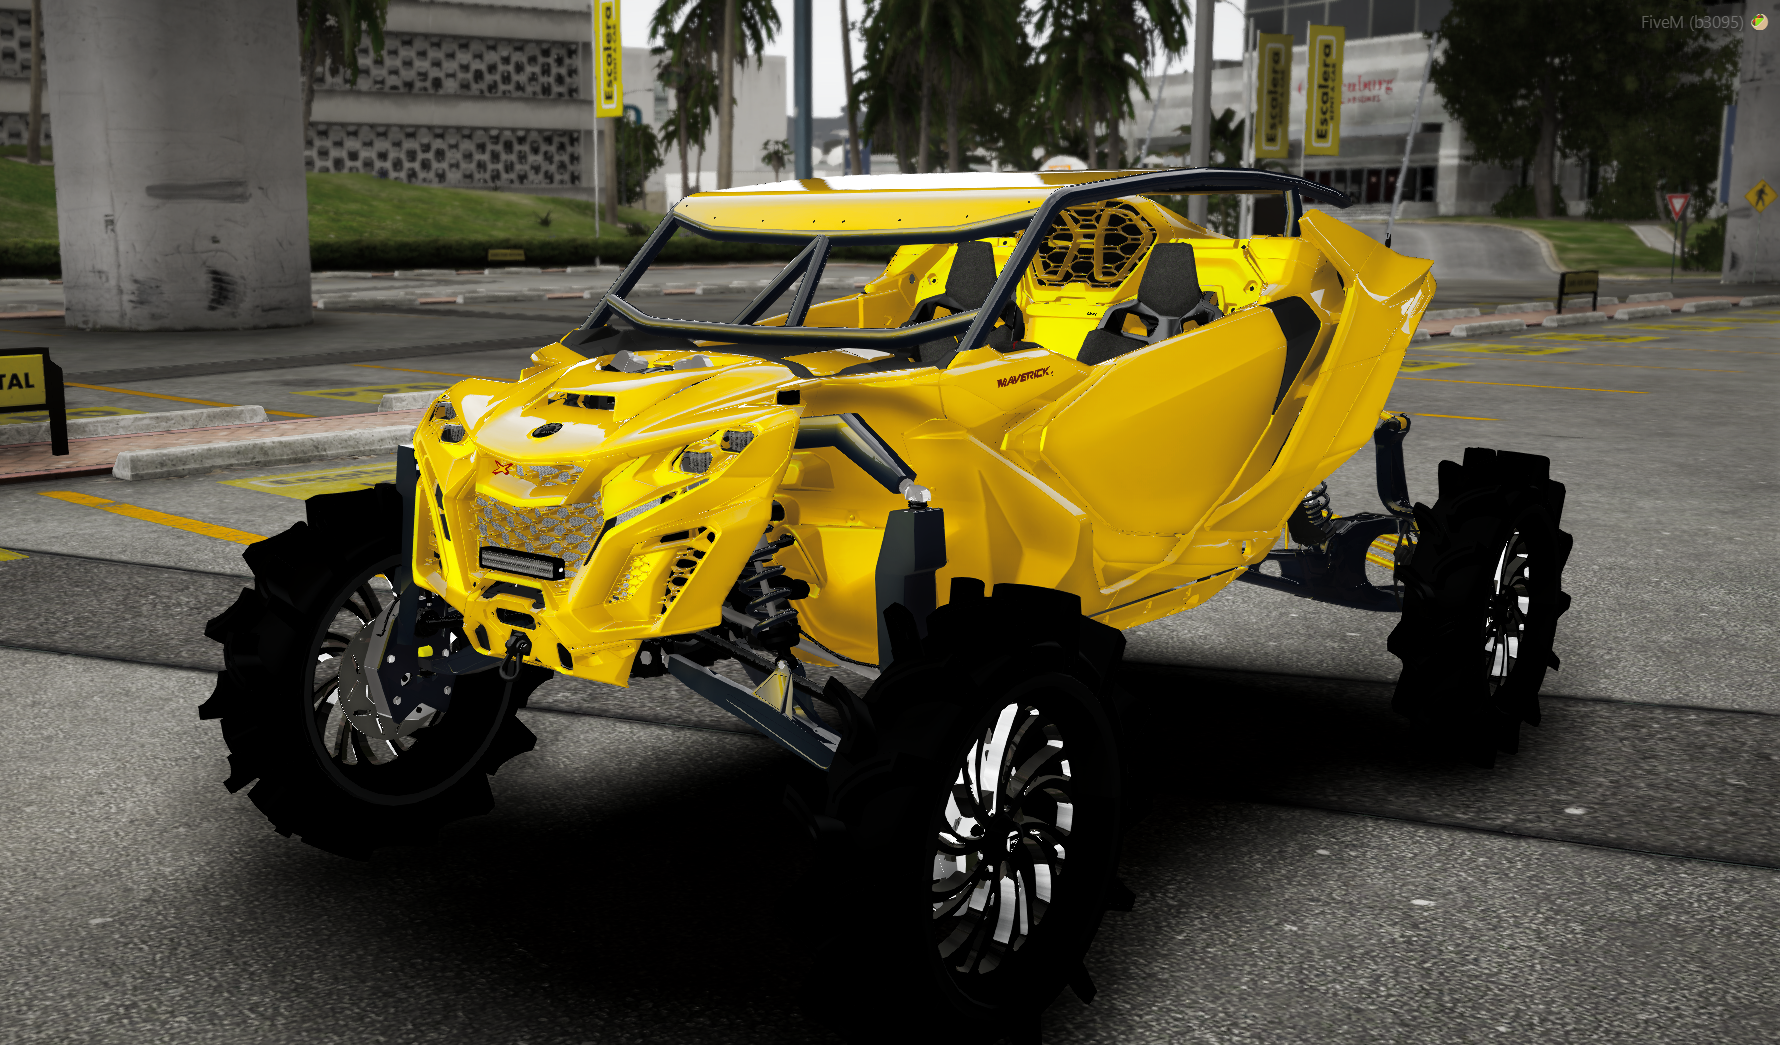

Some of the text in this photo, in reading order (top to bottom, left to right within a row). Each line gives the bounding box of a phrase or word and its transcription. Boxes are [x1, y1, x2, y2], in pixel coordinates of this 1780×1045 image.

[603, 6, 613, 101] Escalera
[1266, 50, 1280, 143] Escalera
[1316, 43, 1332, 139] Escalera
[997, 366, 1050, 388] MAVERICK
